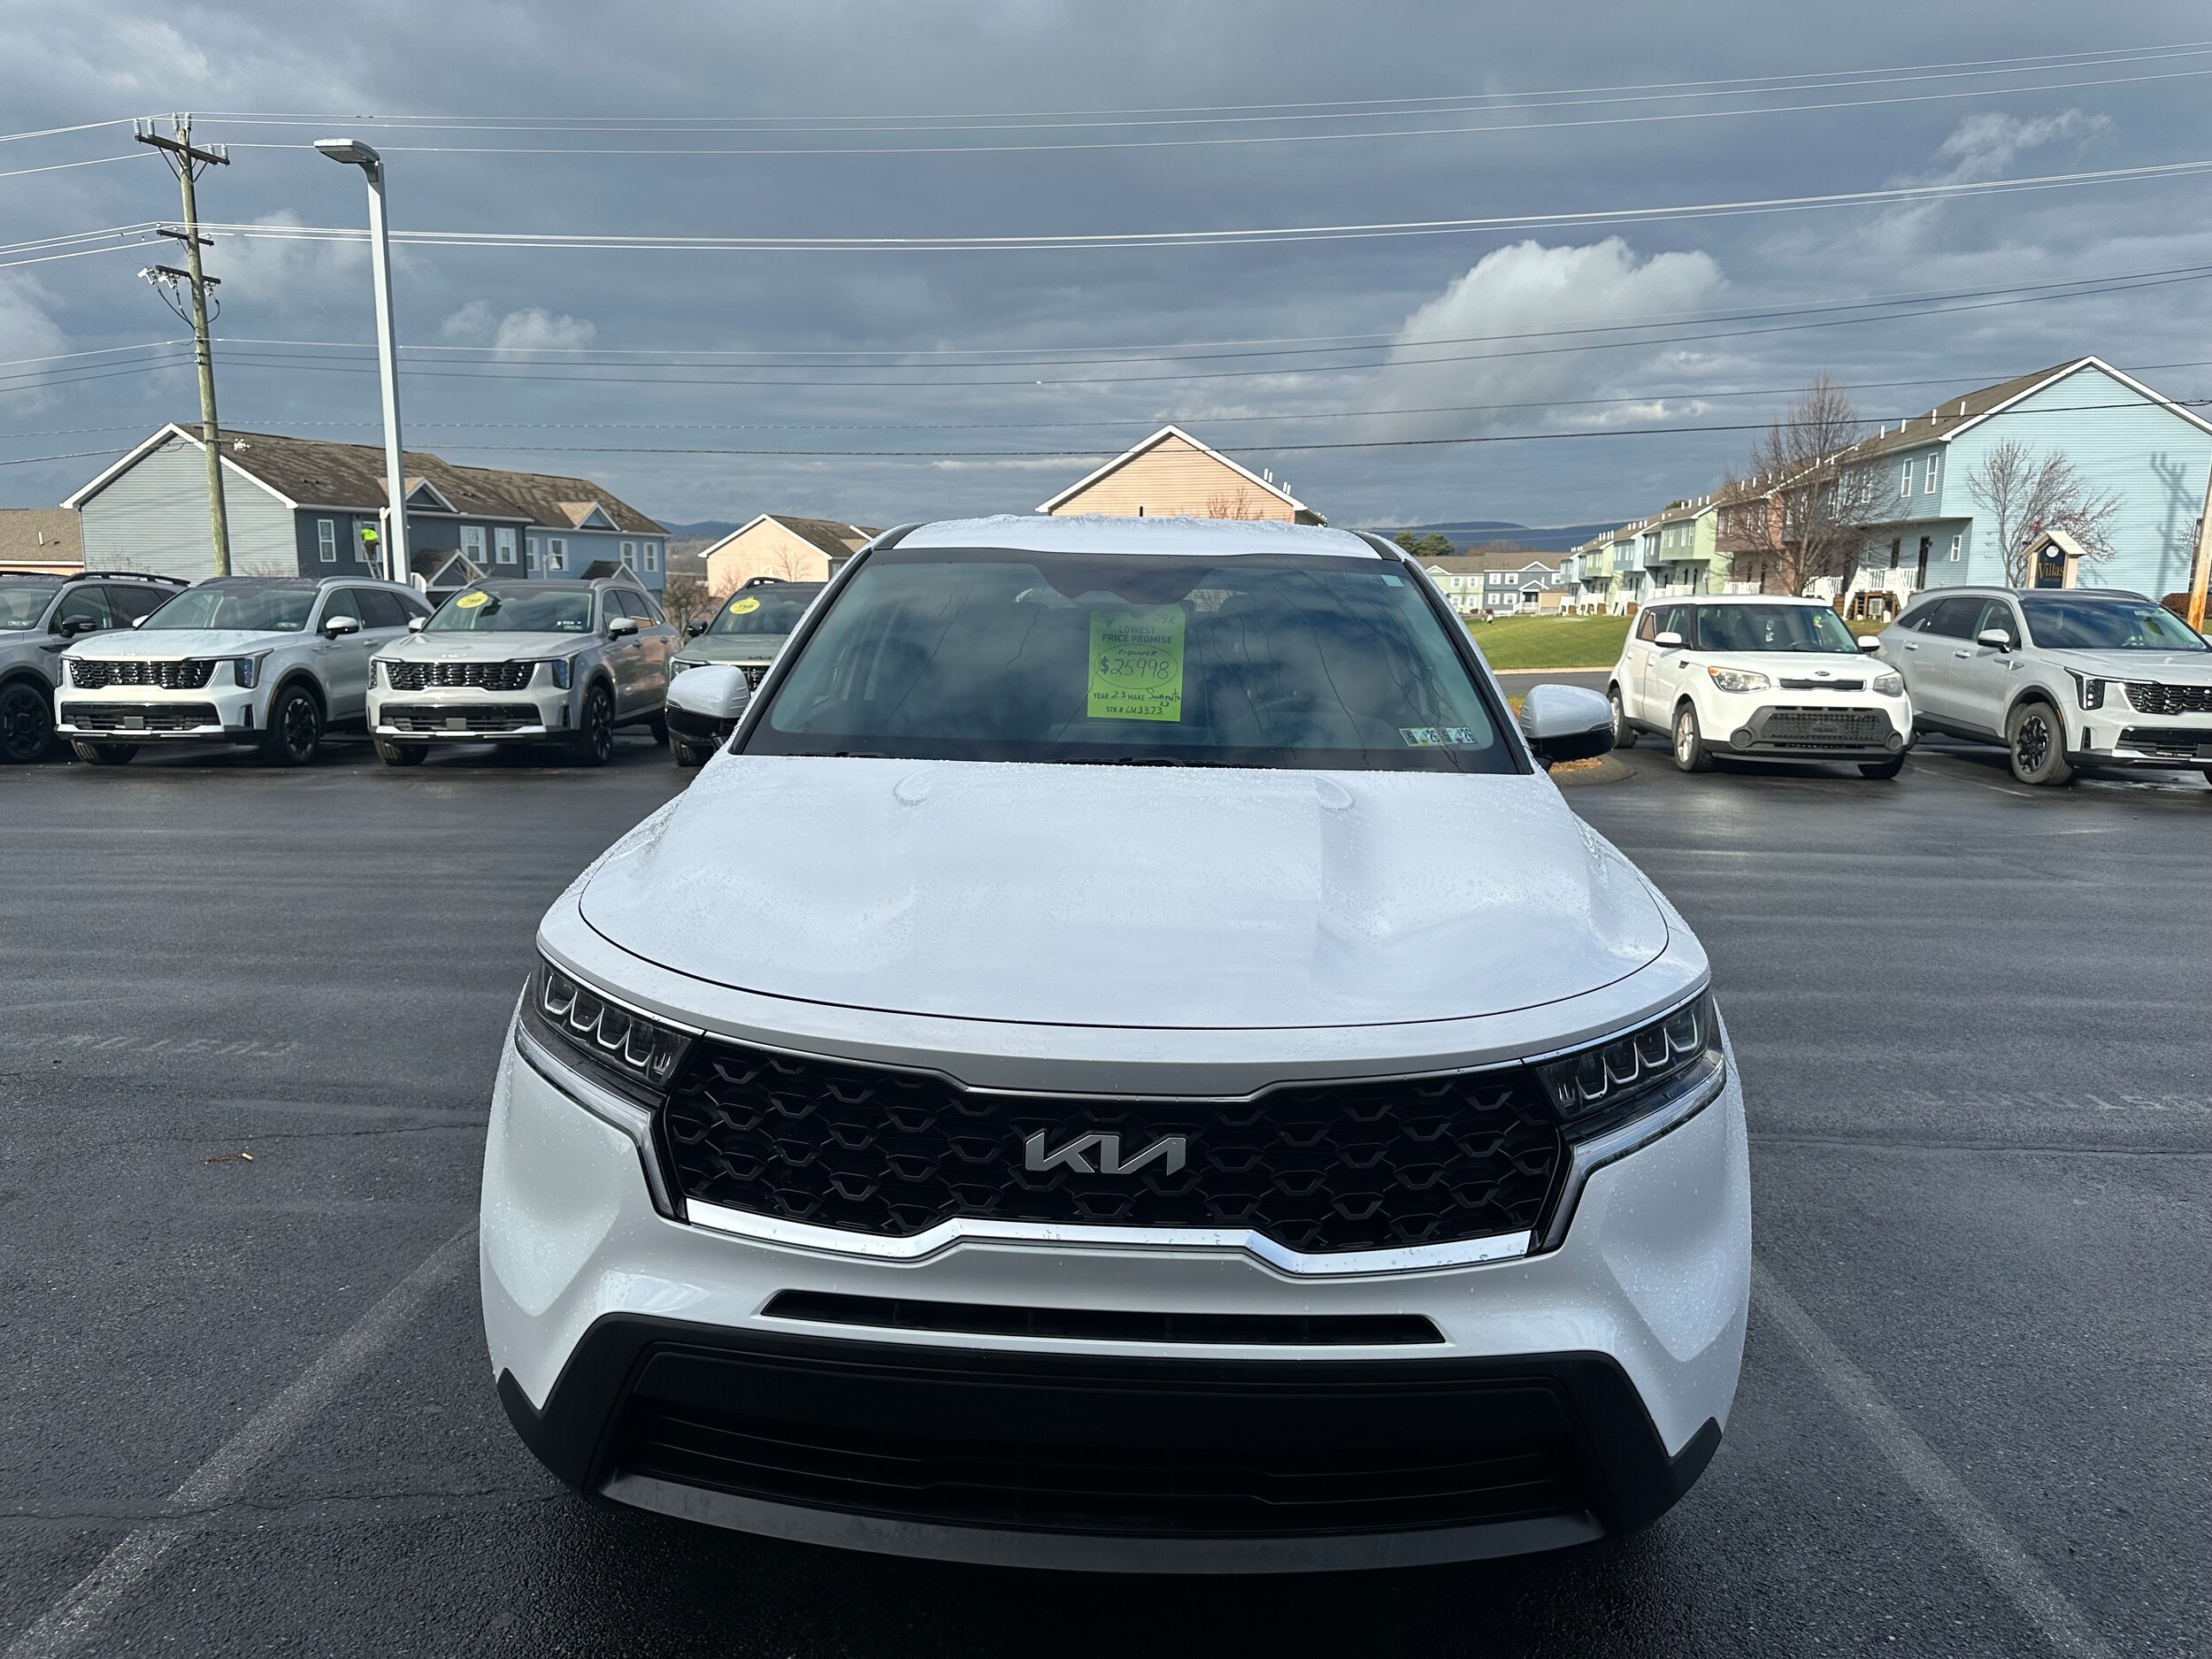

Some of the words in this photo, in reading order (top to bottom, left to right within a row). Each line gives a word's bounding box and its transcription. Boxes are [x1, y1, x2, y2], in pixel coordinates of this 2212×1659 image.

[2039, 562, 2063, 580] Villas
[1118, 626, 1156, 634] LOWEST
[1131, 634, 1172, 643] PROMISE
[1025, 1132, 1187, 1176] KIA
